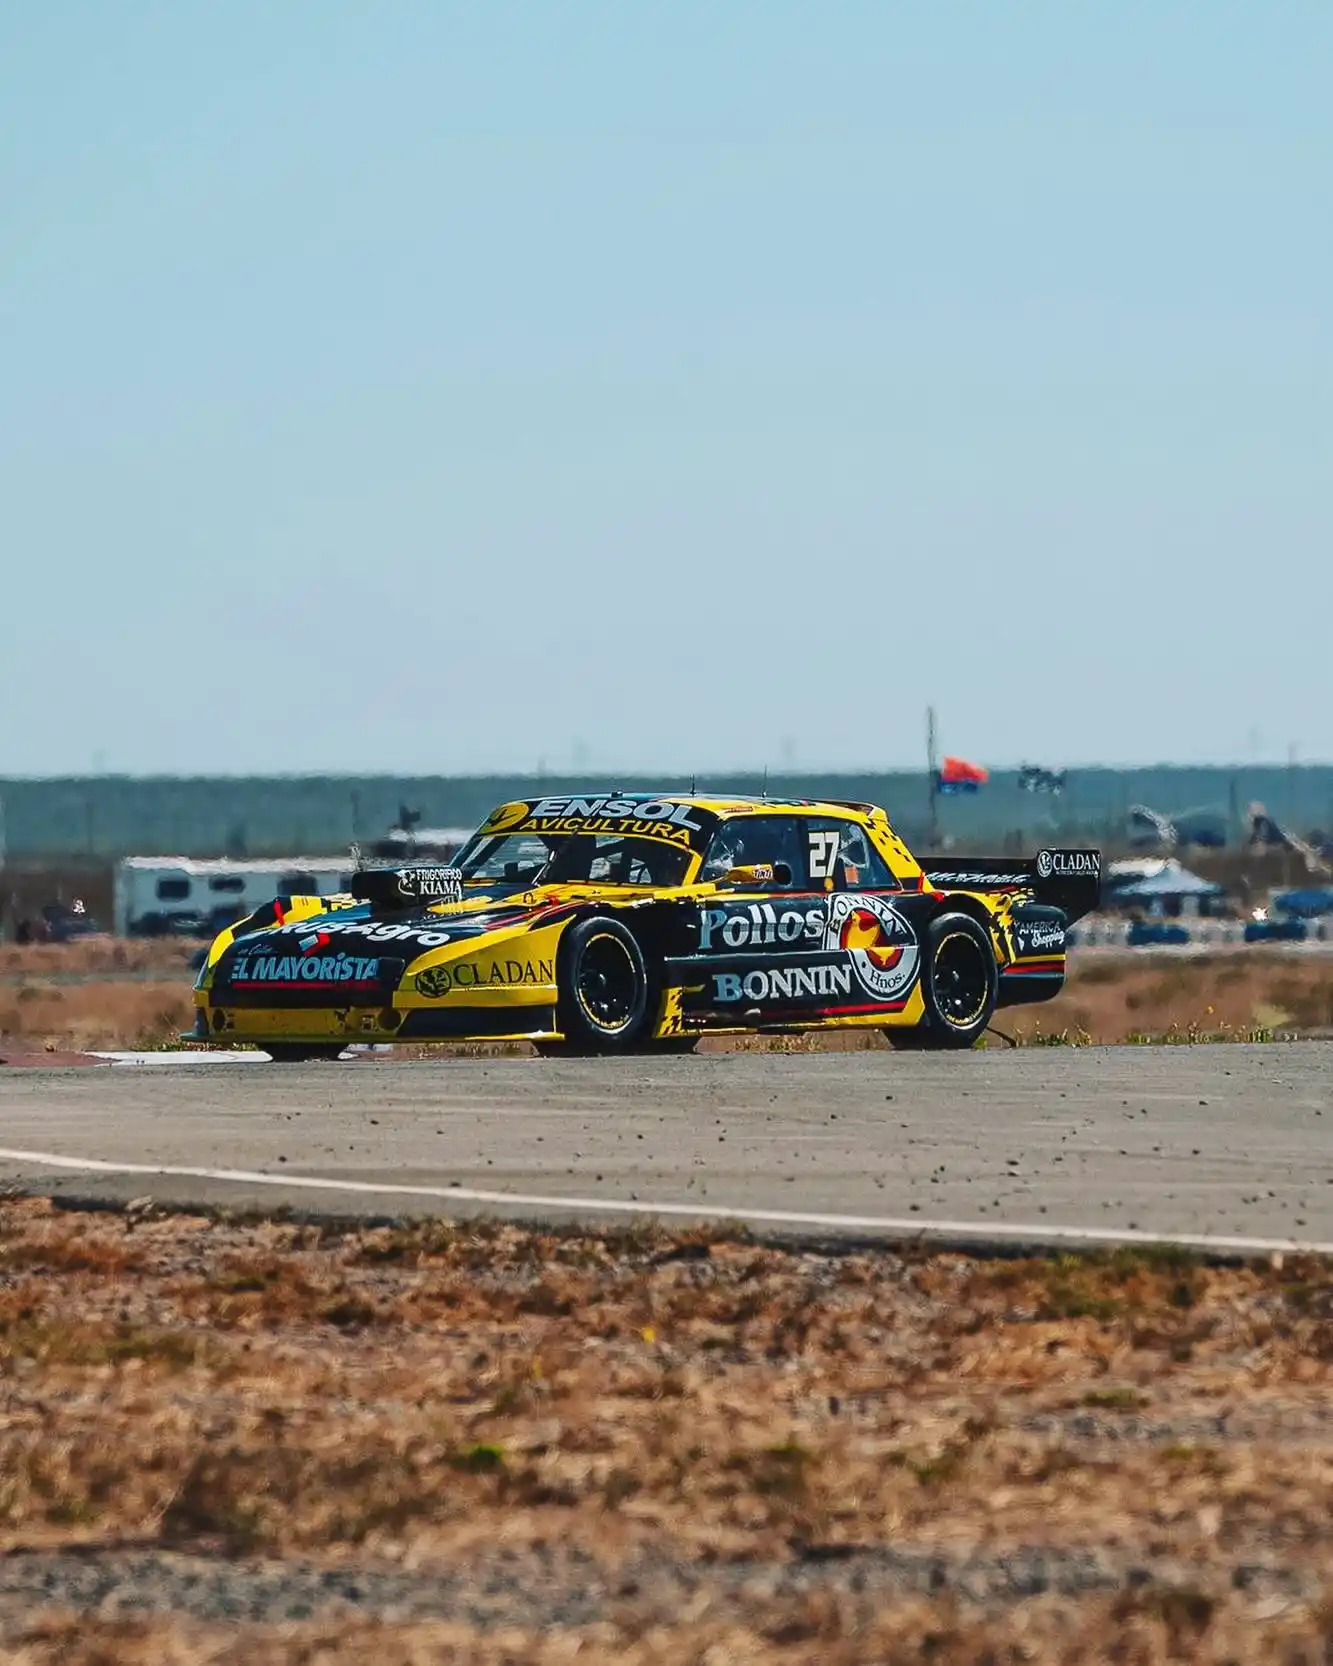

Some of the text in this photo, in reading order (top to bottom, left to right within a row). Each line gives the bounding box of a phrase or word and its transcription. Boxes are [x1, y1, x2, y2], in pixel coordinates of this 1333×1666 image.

[530, 799, 702, 831] ENSOL
[519, 816, 691, 845] AVICULTURA
[808, 831, 840, 878] 27
[1053, 853, 1100, 870] CLADAN
[420, 880, 462, 896] KIAMA
[698, 902, 825, 949] Pollos
[231, 957, 249, 979] EL
[453, 959, 553, 986] CLADAN
[712, 963, 852, 1001] BONNIN
